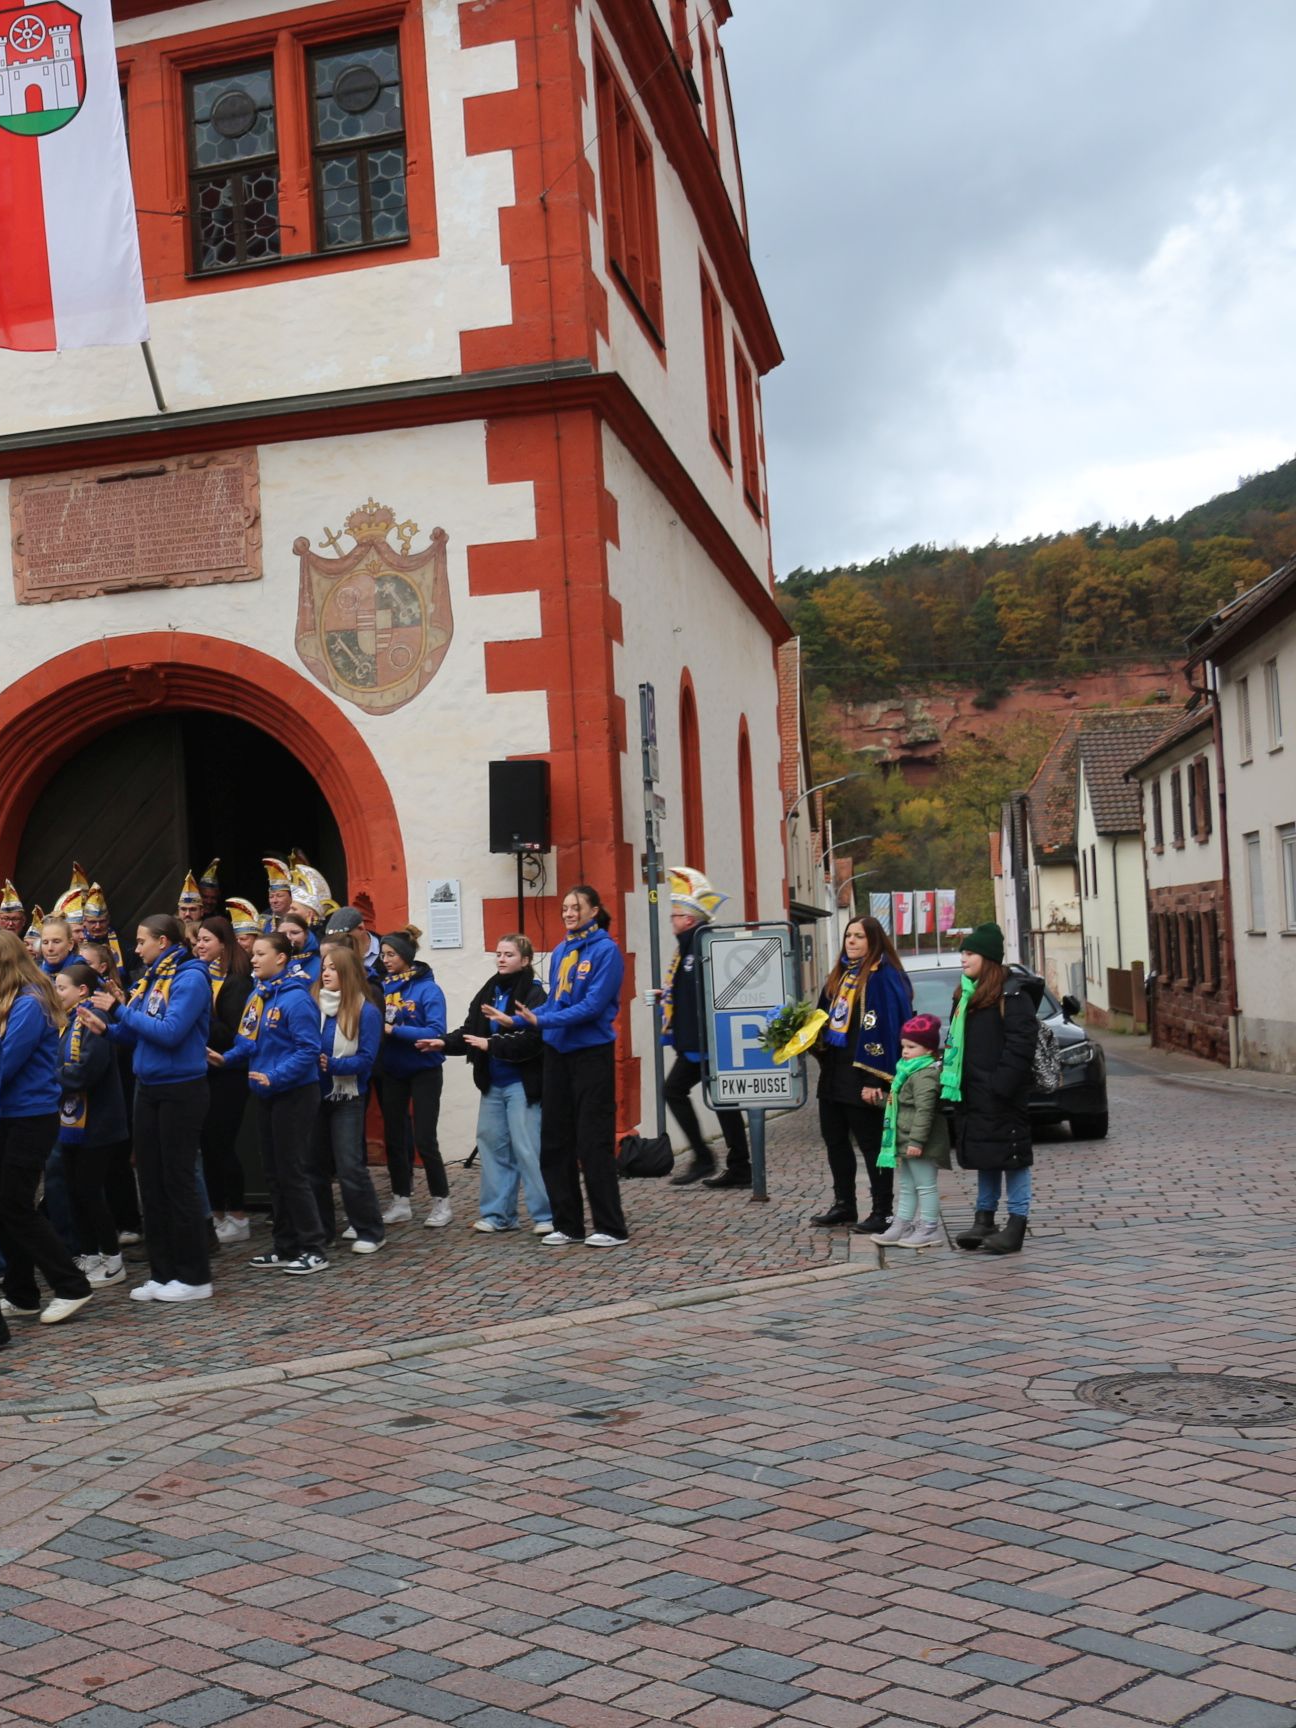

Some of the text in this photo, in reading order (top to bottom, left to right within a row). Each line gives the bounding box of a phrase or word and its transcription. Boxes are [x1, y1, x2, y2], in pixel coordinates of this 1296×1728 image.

[731, 992, 767, 1005] ZONE
[730, 1014, 769, 1068] P
[721, 1076, 788, 1095] PKW-BUSSE
